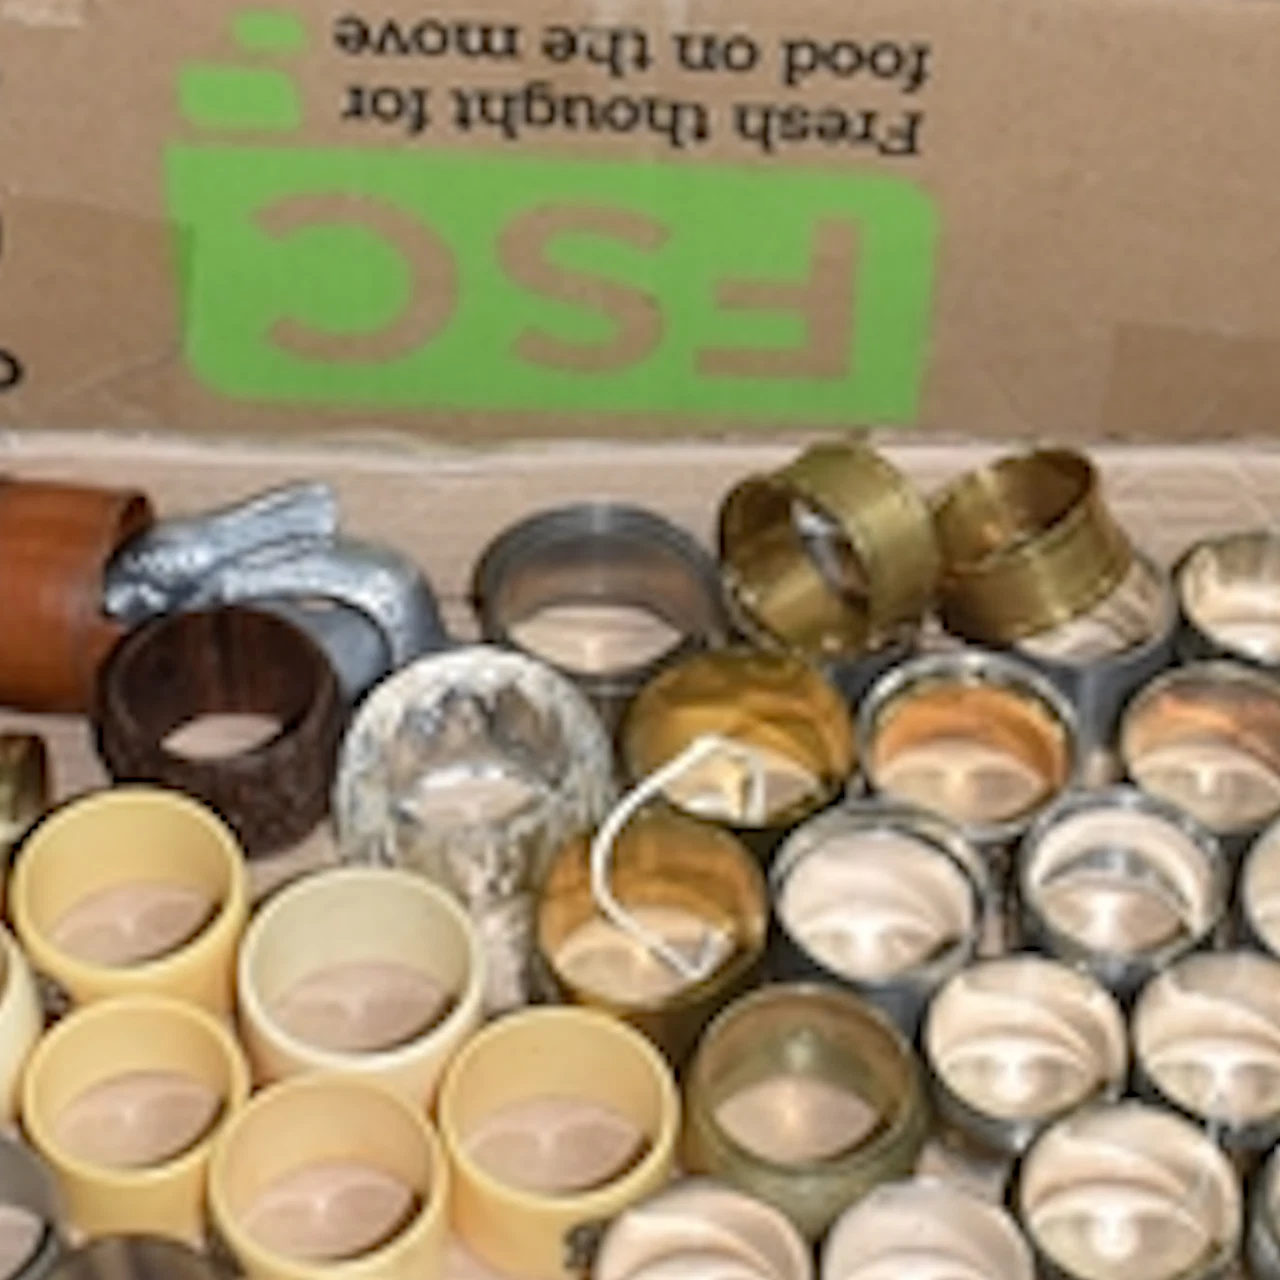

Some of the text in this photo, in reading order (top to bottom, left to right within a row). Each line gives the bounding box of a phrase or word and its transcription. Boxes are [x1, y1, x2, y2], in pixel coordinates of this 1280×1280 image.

[332, 16, 931, 95] food on the move
[340, 80, 926, 157] Fresh thought for
[248, 190, 865, 380] FSC
